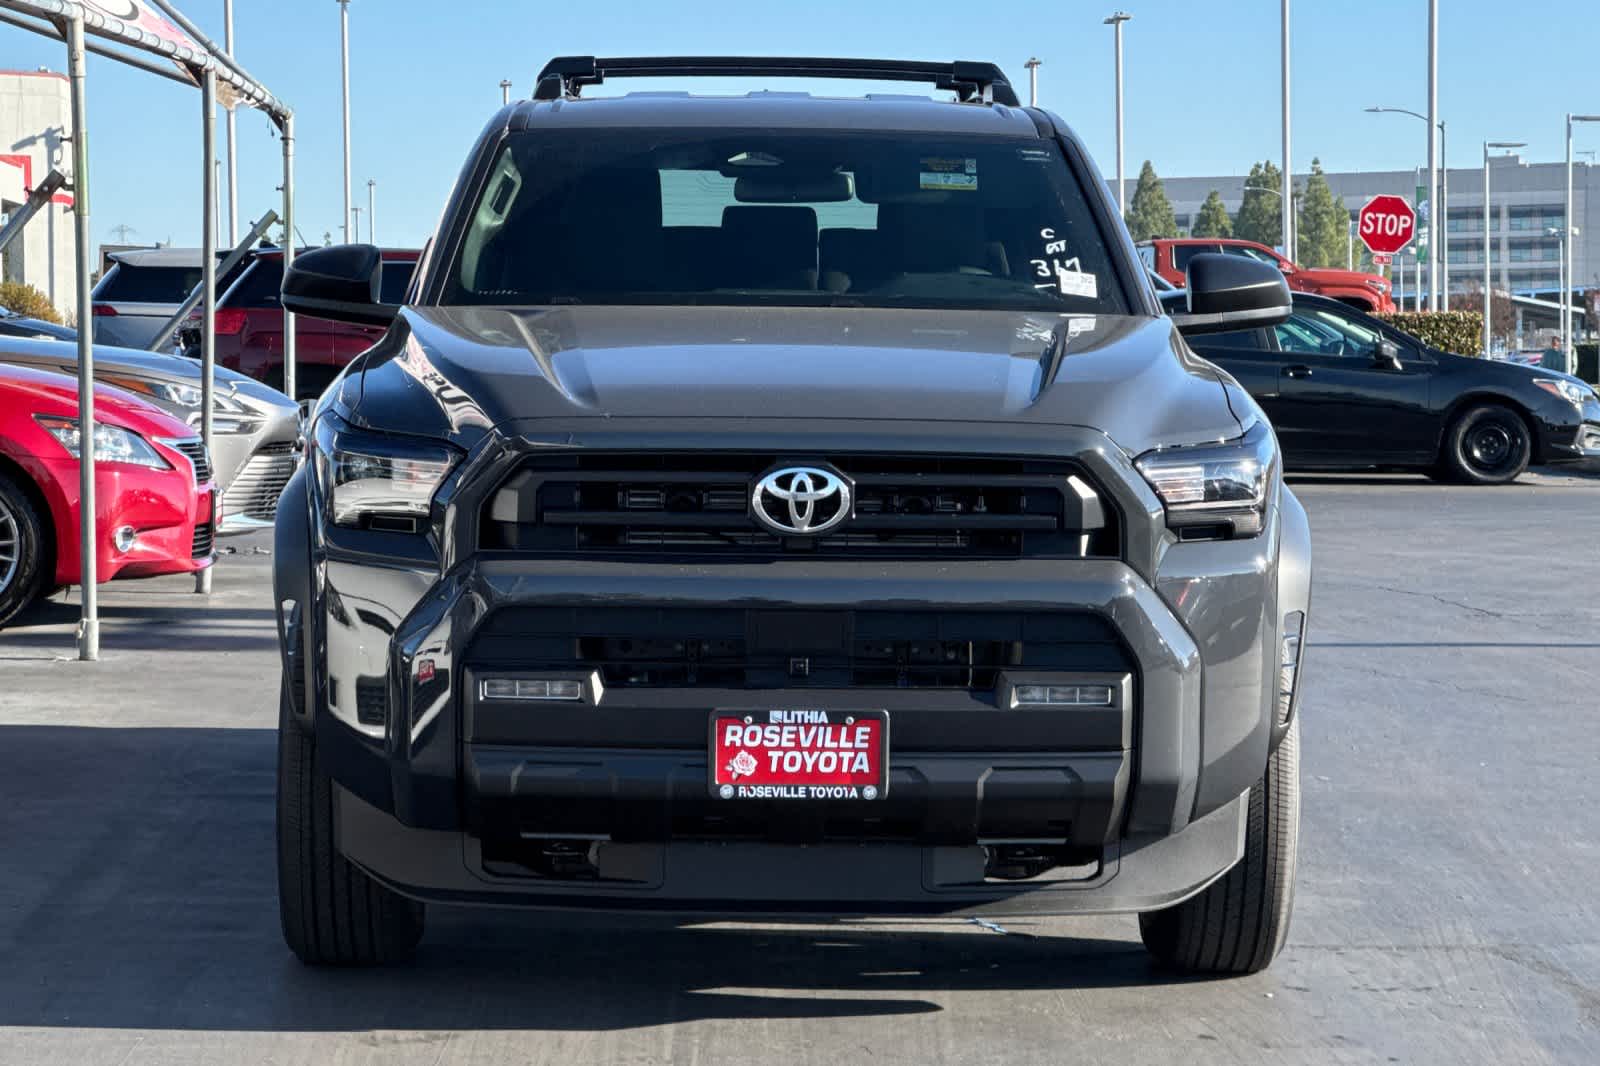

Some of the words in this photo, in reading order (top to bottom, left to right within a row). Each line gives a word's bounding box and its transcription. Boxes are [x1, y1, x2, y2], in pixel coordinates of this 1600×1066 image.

[1362, 212, 1411, 237] STOP
[783, 710, 829, 724] LITHIA
[724, 725, 871, 749] ROSEVILLE
[768, 751, 870, 773] TOYOTA
[738, 786, 807, 798] ROSEVILLE
[809, 787, 858, 799] TOYOTA
